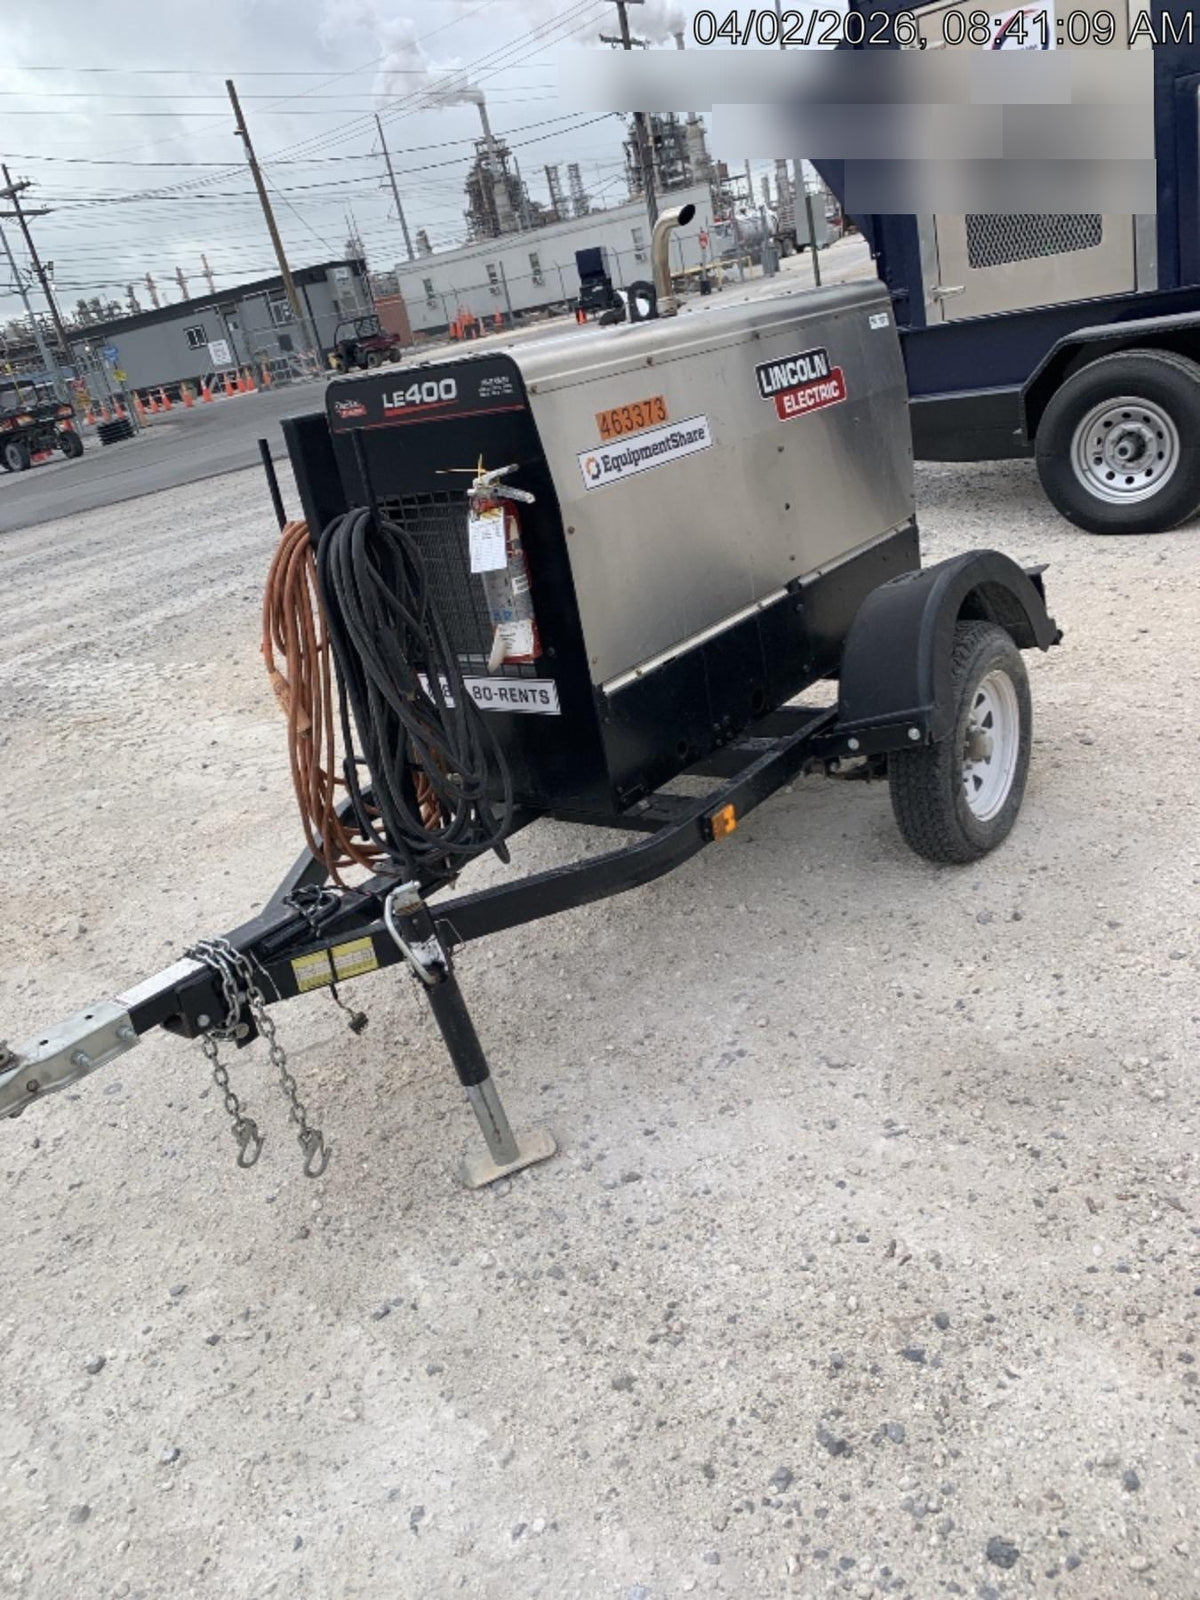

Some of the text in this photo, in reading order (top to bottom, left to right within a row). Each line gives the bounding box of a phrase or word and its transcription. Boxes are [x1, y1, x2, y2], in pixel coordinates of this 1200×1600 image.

[382, 378, 457, 408] LE400
[760, 353, 828, 394] LINCOLN
[600, 397, 667, 437] 463373
[783, 380, 840, 414] ELECTRIC
[600, 427, 706, 473] EquipmentShare
